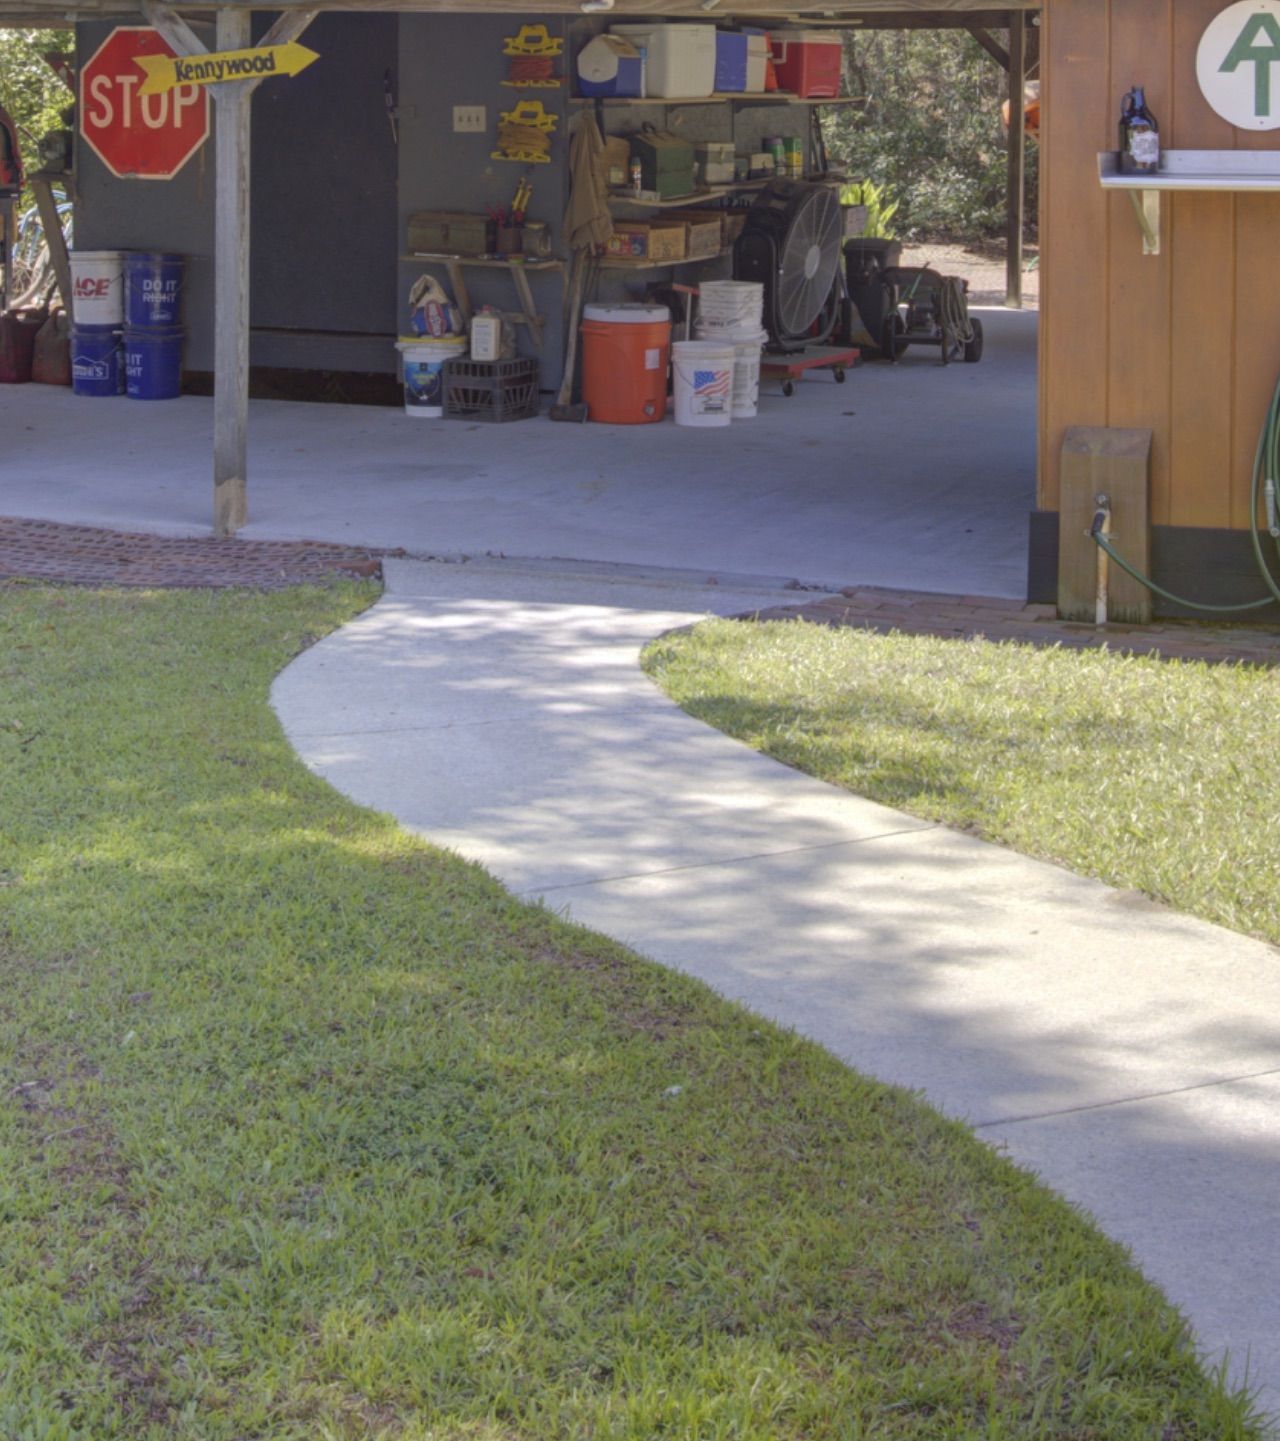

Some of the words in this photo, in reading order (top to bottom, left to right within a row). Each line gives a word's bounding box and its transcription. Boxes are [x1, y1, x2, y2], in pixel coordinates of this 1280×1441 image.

[174, 51, 276, 83] Kennywood
[89, 74, 200, 129] STOP
[73, 276, 111, 297] ACE
[142, 279, 162, 292] DO
[166, 279, 177, 292] IT
